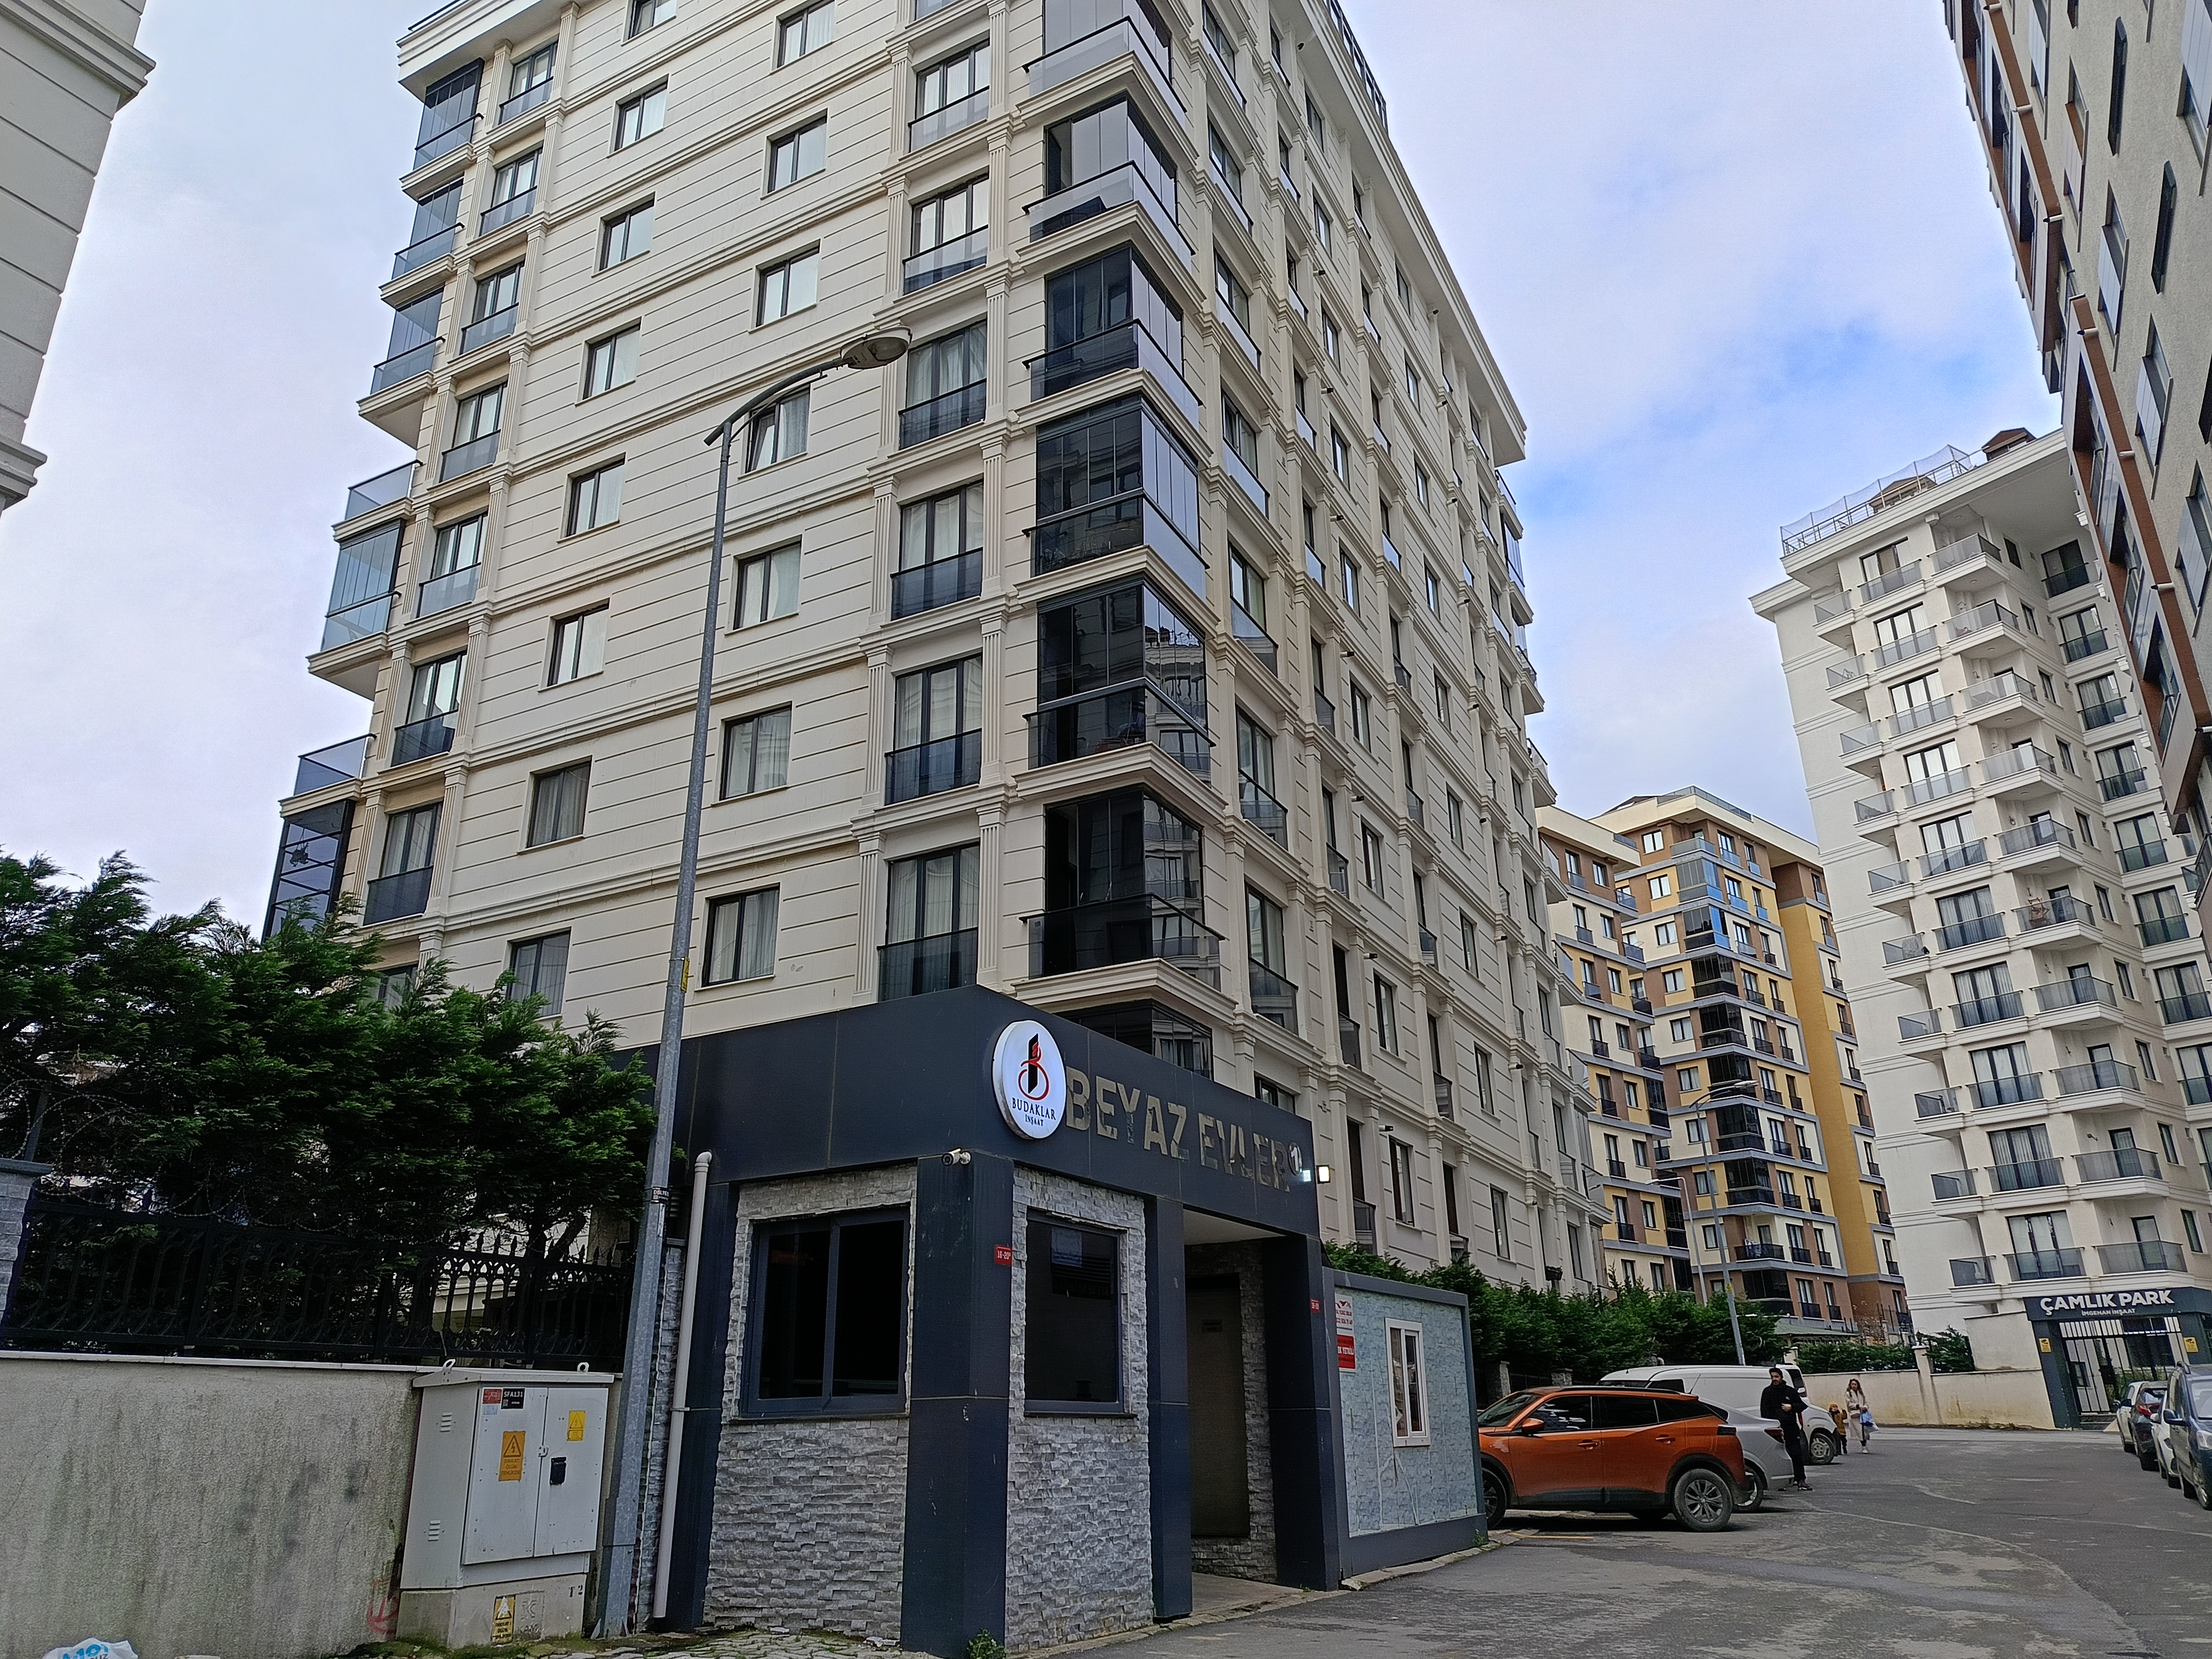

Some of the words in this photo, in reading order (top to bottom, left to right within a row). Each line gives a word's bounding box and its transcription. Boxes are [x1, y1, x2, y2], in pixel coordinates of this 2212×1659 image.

[1012, 1097, 1056, 1120] BUDAKLAR
[1025, 1113, 1044, 1127] İNŞAAT
[1066, 1066, 1189, 1161] BEYAZ
[2040, 1293, 2117, 1316] ÇAMLIK
[2118, 1290, 2174, 1307] PARK
